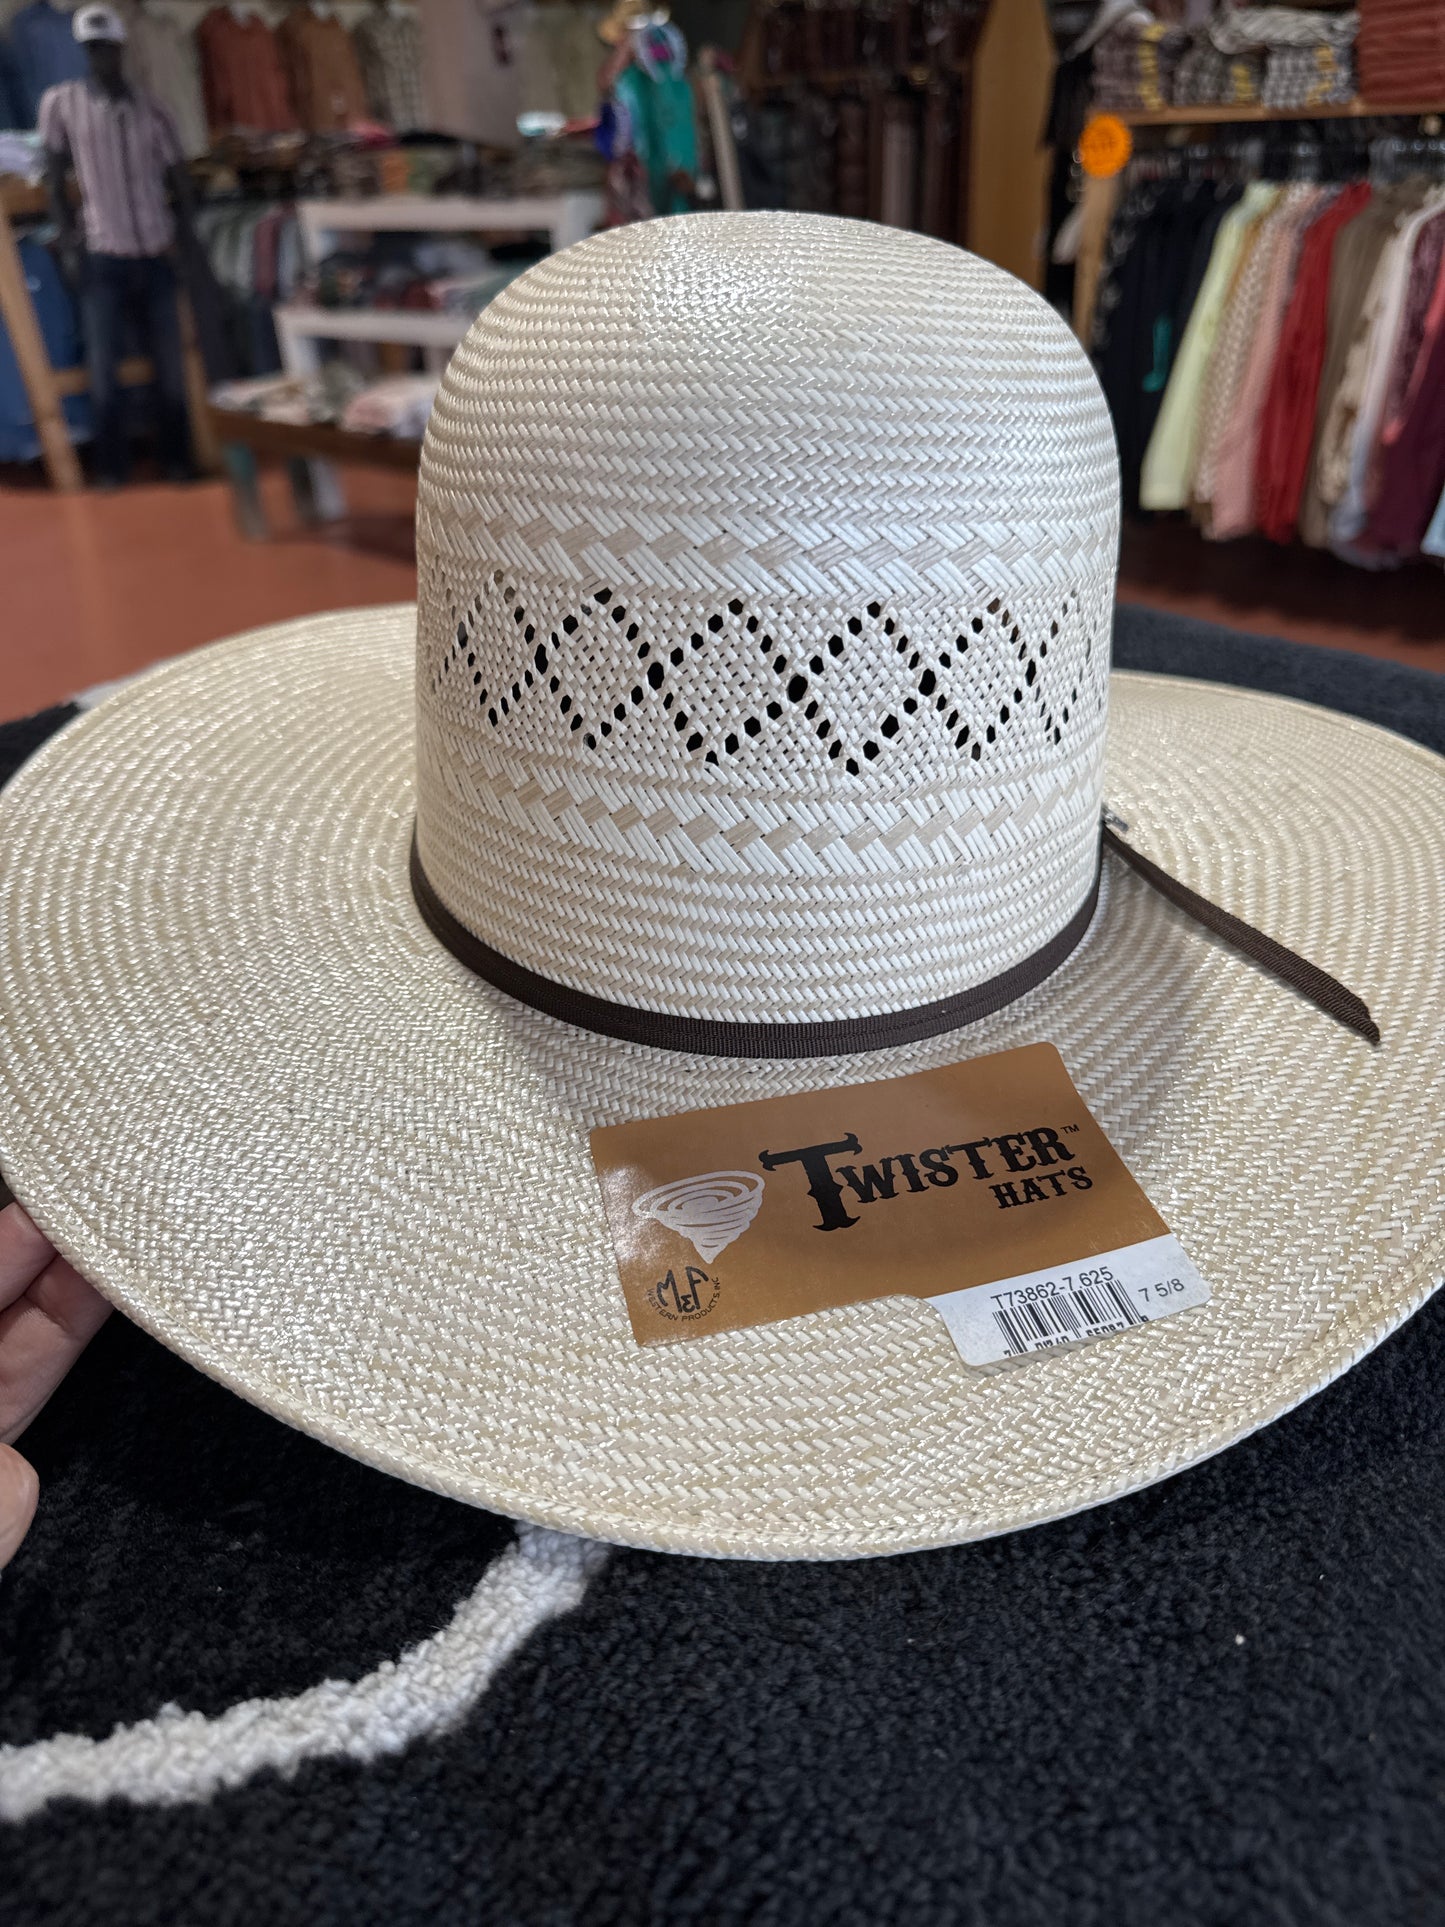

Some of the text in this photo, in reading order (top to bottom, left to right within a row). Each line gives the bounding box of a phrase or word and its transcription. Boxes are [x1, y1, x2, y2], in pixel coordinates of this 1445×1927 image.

[758, 1127, 1075, 1232] TWISTER
[988, 1166, 1093, 1209] HATS
[647, 1288, 679, 1321] WESTERN
[990, 1266, 1114, 1310] T73862-7.625
[1138, 1278, 1185, 1303] 7 5/8
